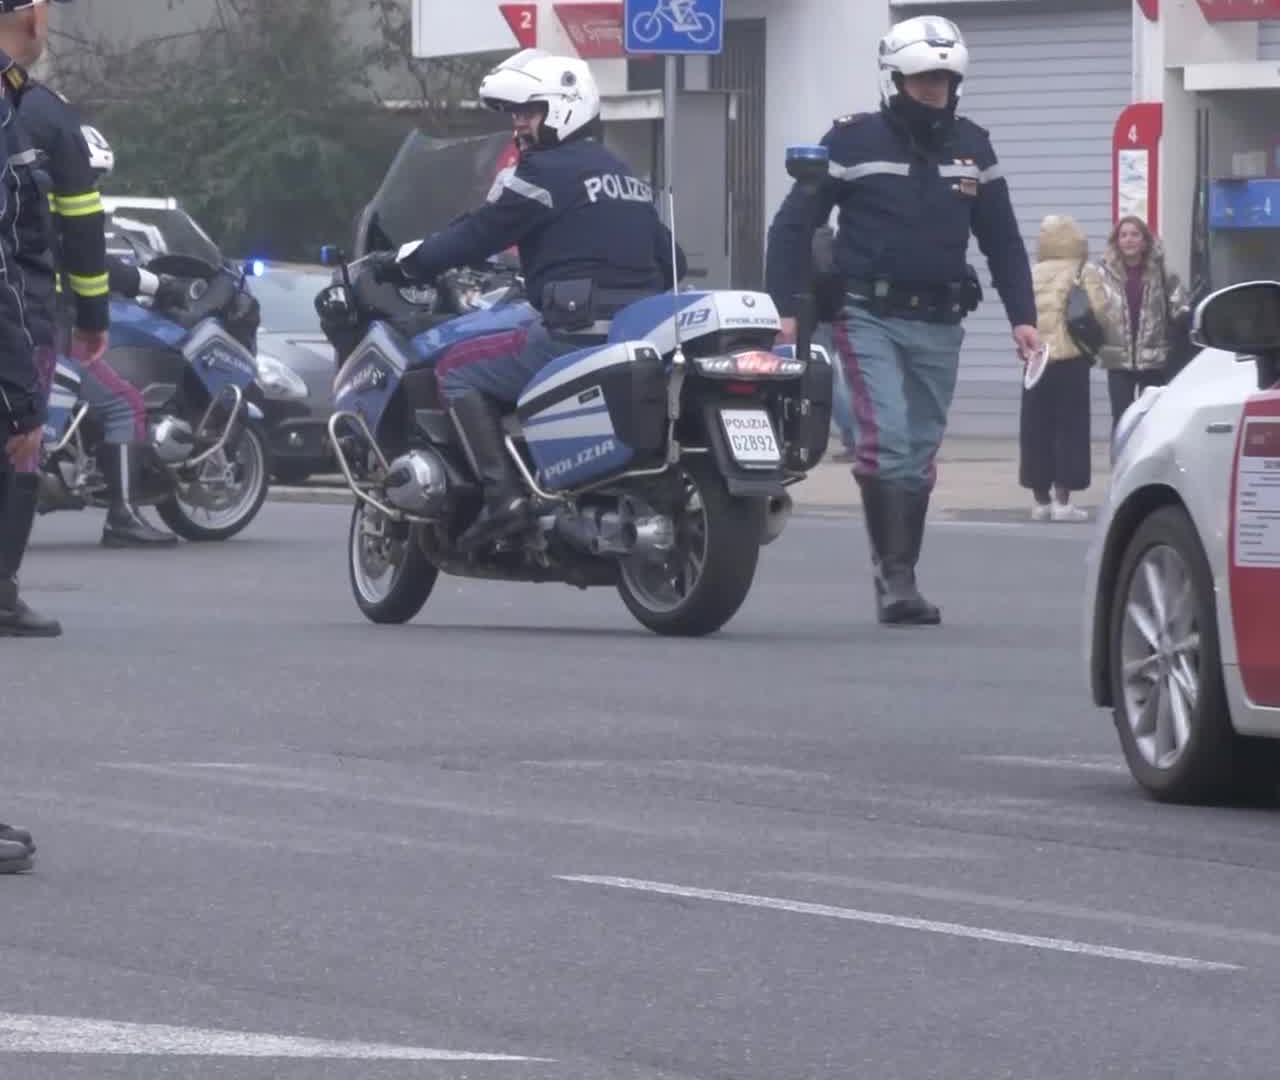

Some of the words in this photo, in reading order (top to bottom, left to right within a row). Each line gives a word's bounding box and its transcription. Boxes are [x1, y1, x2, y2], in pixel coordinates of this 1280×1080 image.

[520, 10, 533, 30] 2
[1127, 123, 1138, 144] 4
[724, 418, 770, 430] POLIZIA
[731, 434, 777, 451] G2892
[544, 439, 616, 480] POLIZIA
